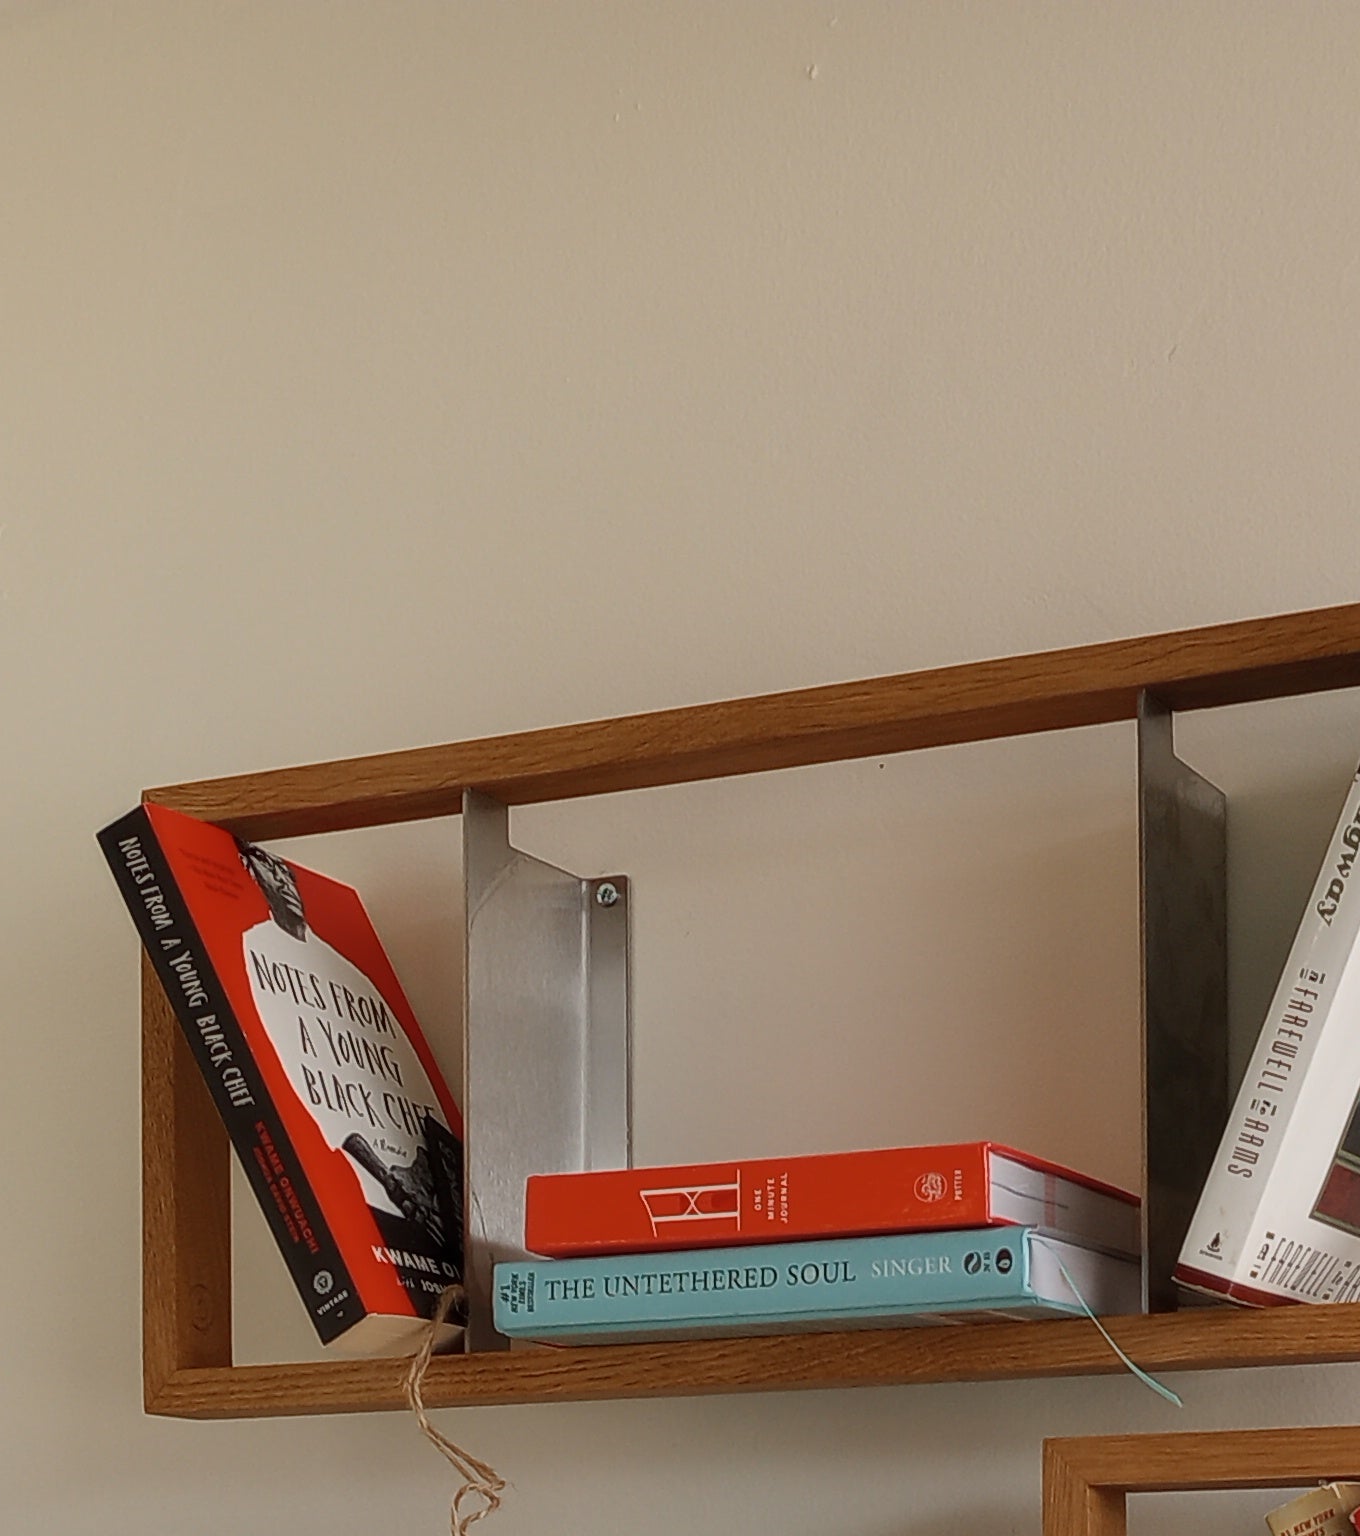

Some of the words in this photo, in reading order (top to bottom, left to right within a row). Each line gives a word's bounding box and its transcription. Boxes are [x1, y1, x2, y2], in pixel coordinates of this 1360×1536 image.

[118, 836, 155, 886] NOTES
[141, 885, 174, 931] FROM
[160, 937, 182, 951] A
[168, 950, 209, 1009] YOUNG
[250, 949, 327, 1011] NOTES
[328, 980, 397, 1039] FROM
[196, 1014, 233, 1068] BLACK
[298, 1015, 317, 1058] A
[316, 1016, 404, 1088] YOUNG
[1257, 986, 1319, 1092] FAREWELL
[221, 1066, 256, 1107] CHEF
[300, 1063, 385, 1129] BLACK
[1227, 1116, 1270, 1179] ARMS
[753, 1188, 762, 1212] ONE
[767, 1177, 775, 1220] MINUTE
[780, 1172, 788, 1224] JOURNAL
[371, 1244, 440, 1275] KWAME
[544, 1279, 595, 1301] THE
[603, 1264, 778, 1298] UNTETHERED
[786, 1261, 856, 1287] SOUL
[871, 1255, 952, 1279] SINGER
